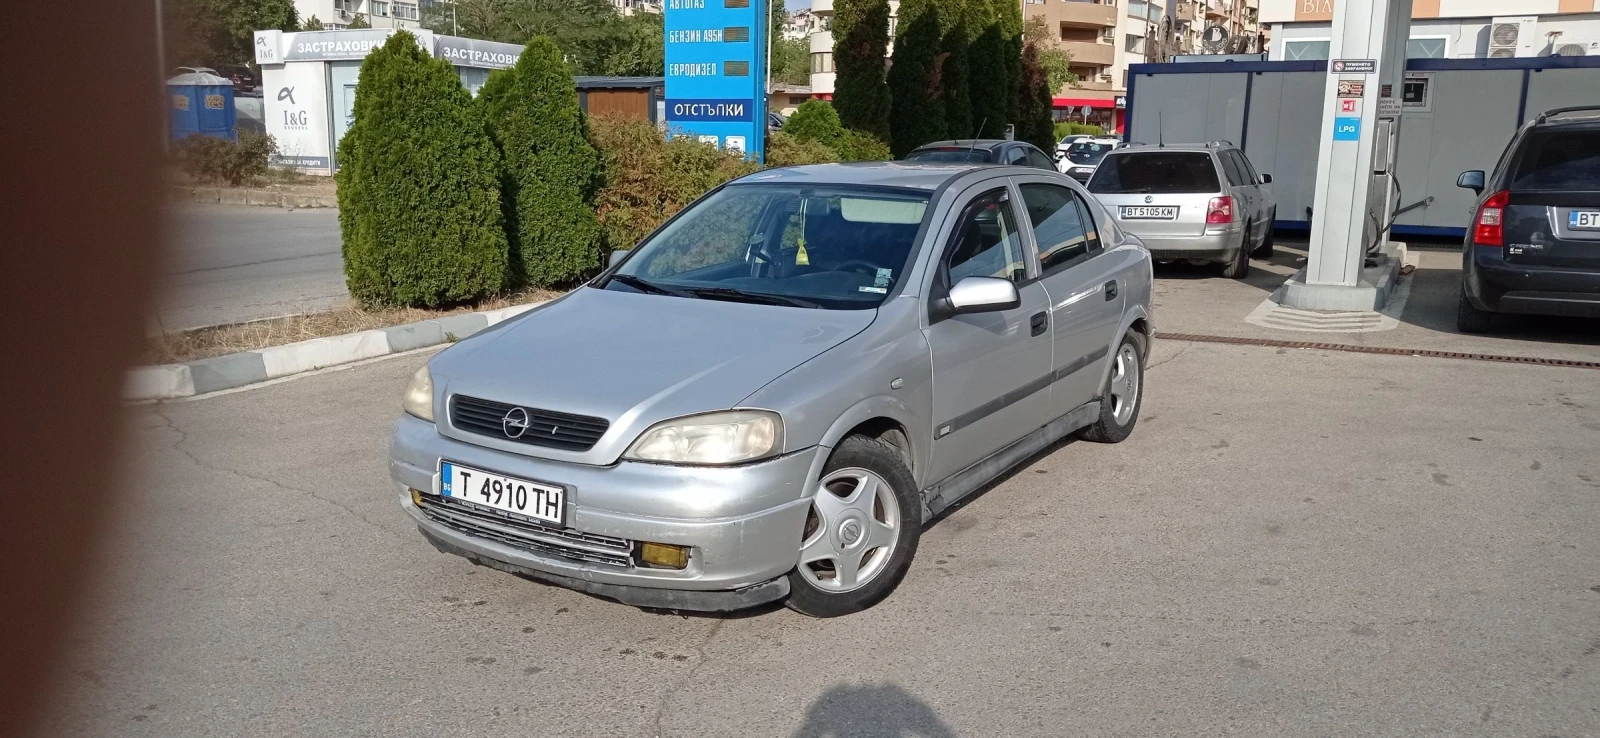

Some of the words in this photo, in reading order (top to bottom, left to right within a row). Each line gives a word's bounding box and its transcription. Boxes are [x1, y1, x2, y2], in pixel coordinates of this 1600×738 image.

[669, 0, 705, 9] АВТОГАЗ
[669, 30, 701, 43] БЕНЗИН
[703, 29, 723, 42] А95Н
[259, 49, 273, 59] I&G
[443, 46, 520, 64] ЗАСТРАХОВК
[669, 63, 717, 77] ЕВРОДИЗЕЛ
[674, 103, 744, 117] ОТСТЪПКИ
[283, 110, 308, 126] I&G
[1338, 125, 1356, 133] LPG
[1127, 207, 1138, 216] BT
[1139, 207, 1160, 216] 5105
[1161, 207, 1173, 217] KM
[1580, 213, 1599, 226] BT
[443, 482, 452, 492] BG
[460, 471, 471, 497] T
[480, 477, 527, 511] 4910
[532, 487, 559, 519] TH
